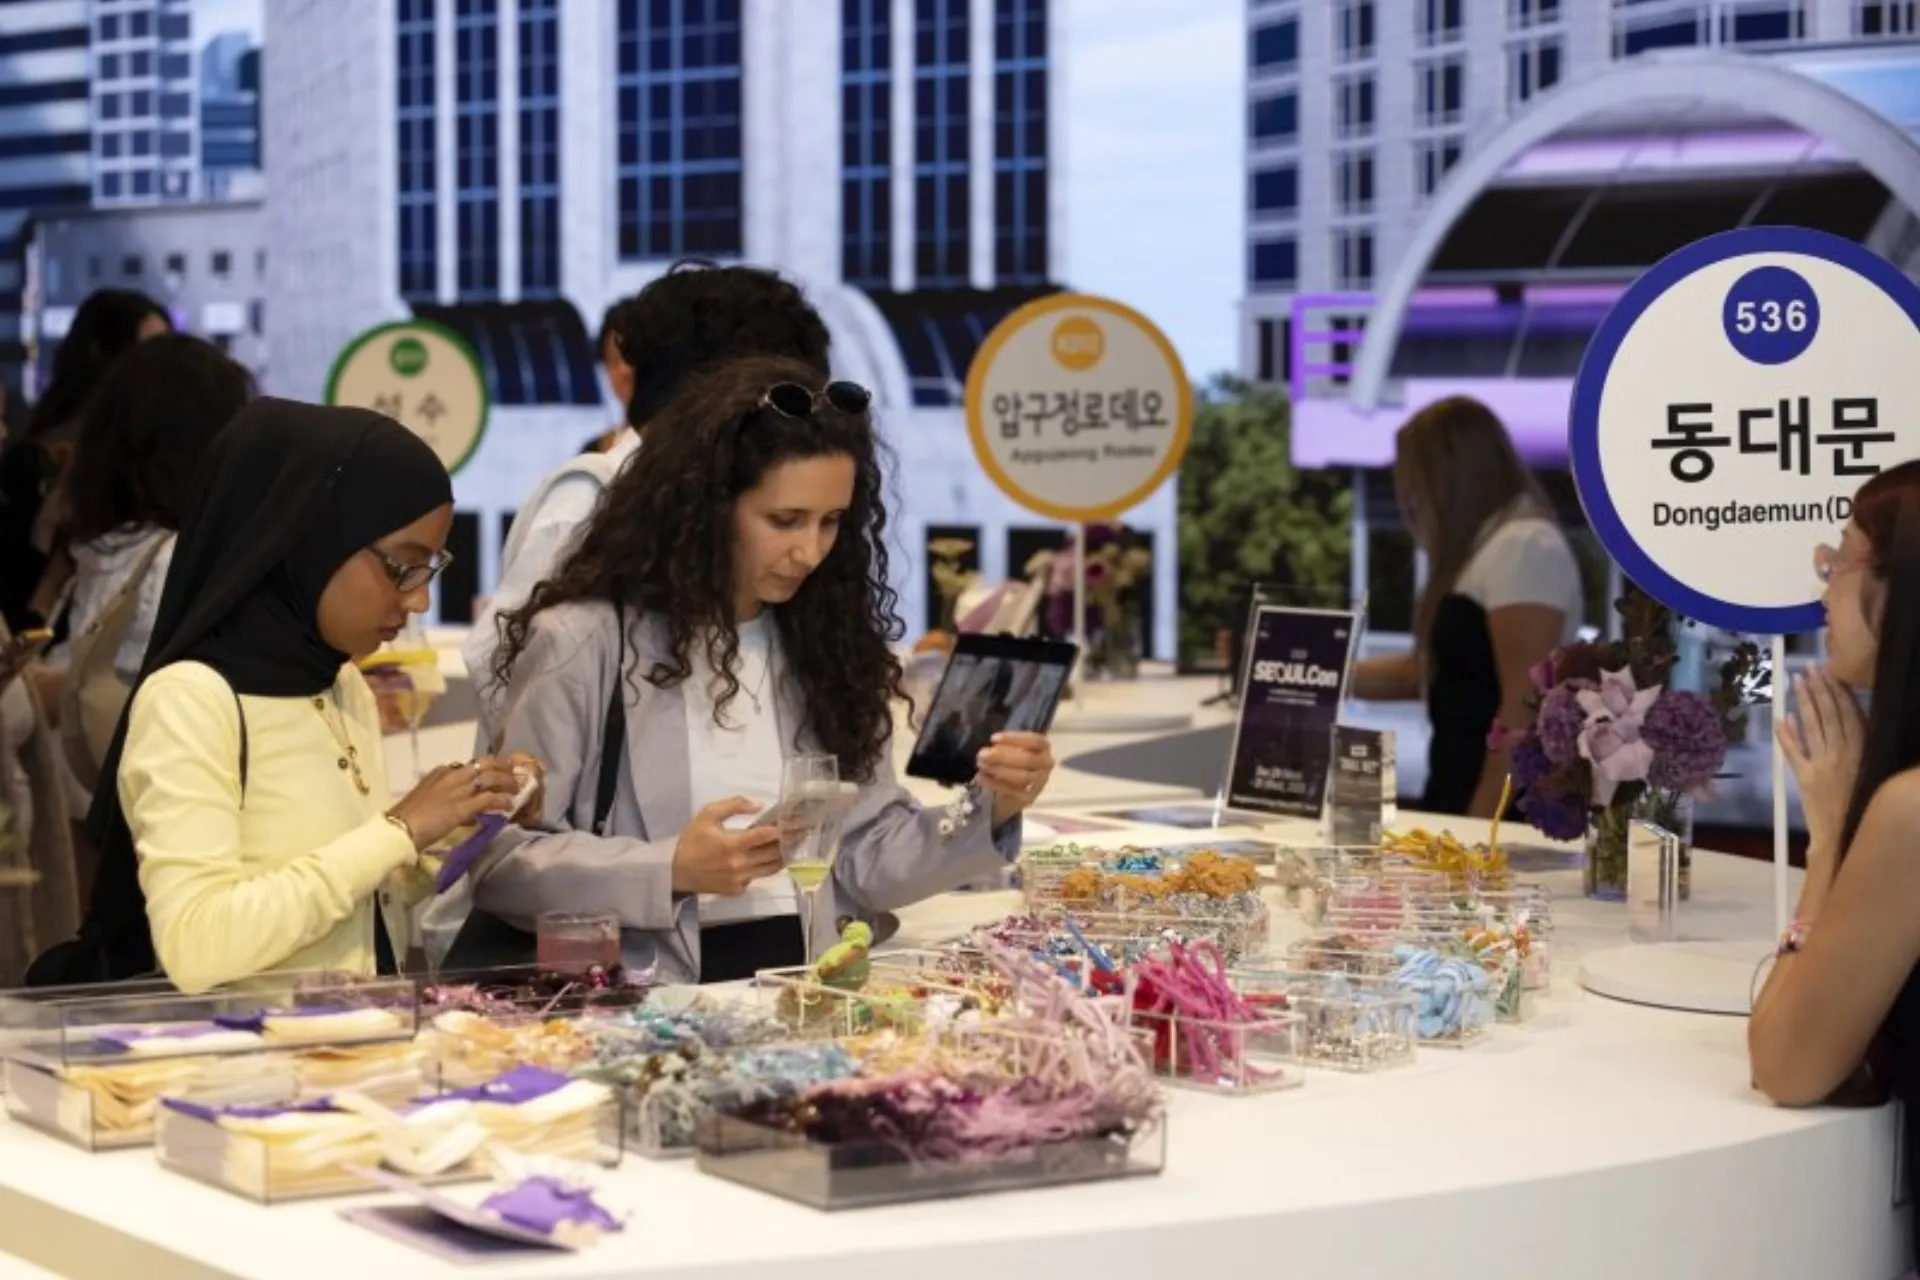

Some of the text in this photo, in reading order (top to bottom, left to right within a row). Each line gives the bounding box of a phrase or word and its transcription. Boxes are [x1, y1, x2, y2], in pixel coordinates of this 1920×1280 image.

[1735, 299, 1807, 333] 536
[991, 388, 1168, 438] 압구정로데오
[1651, 396, 1895, 483] 동대문
[1653, 495, 1854, 530] Dongdaemun(D
